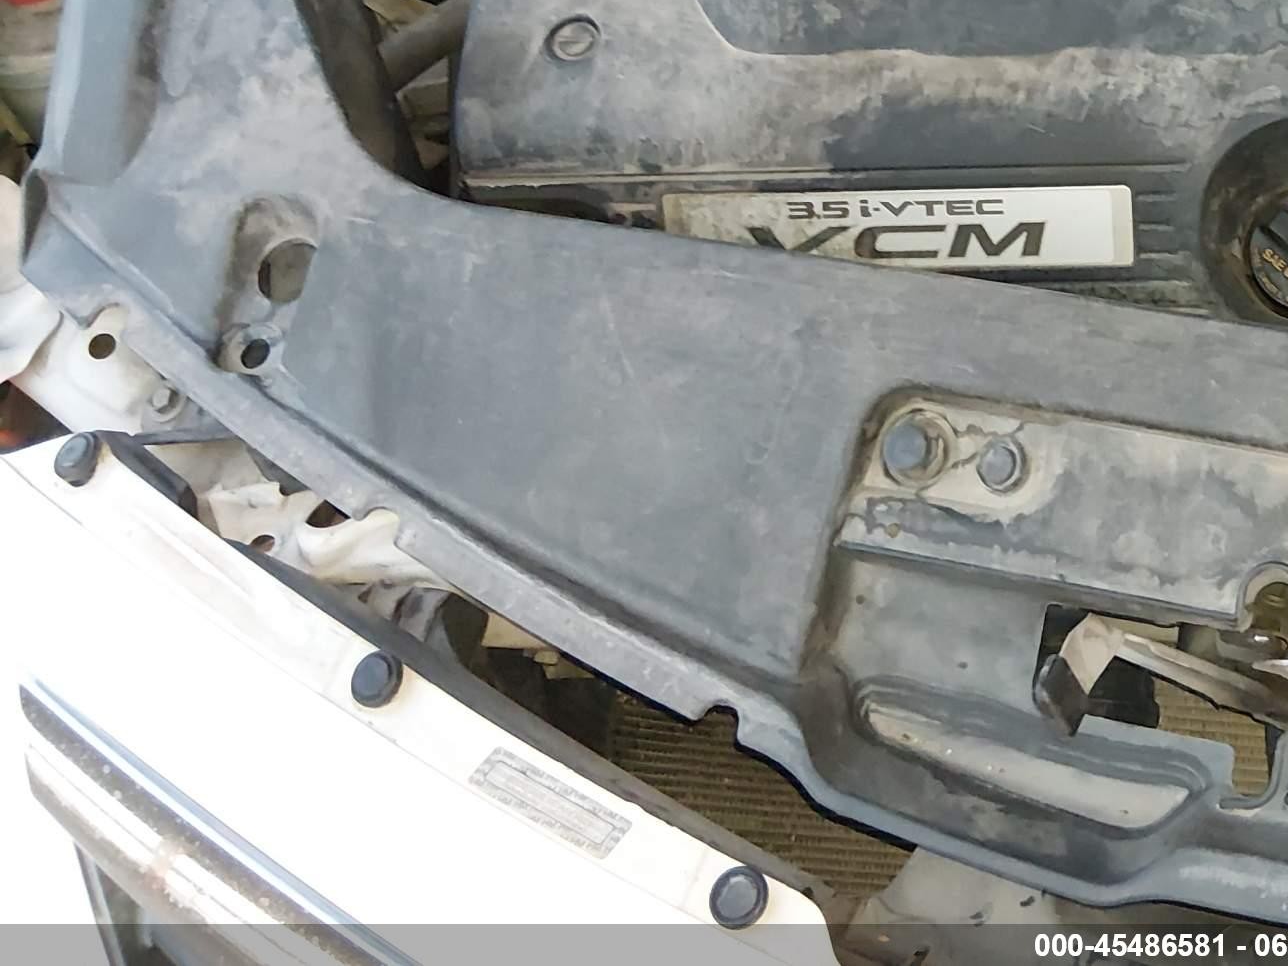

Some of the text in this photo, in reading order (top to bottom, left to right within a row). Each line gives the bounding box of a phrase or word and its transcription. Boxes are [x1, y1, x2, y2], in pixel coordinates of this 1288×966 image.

[787, 199, 1004, 220] 3.5 i-VTEC
[745, 222, 1046, 260] VCM
